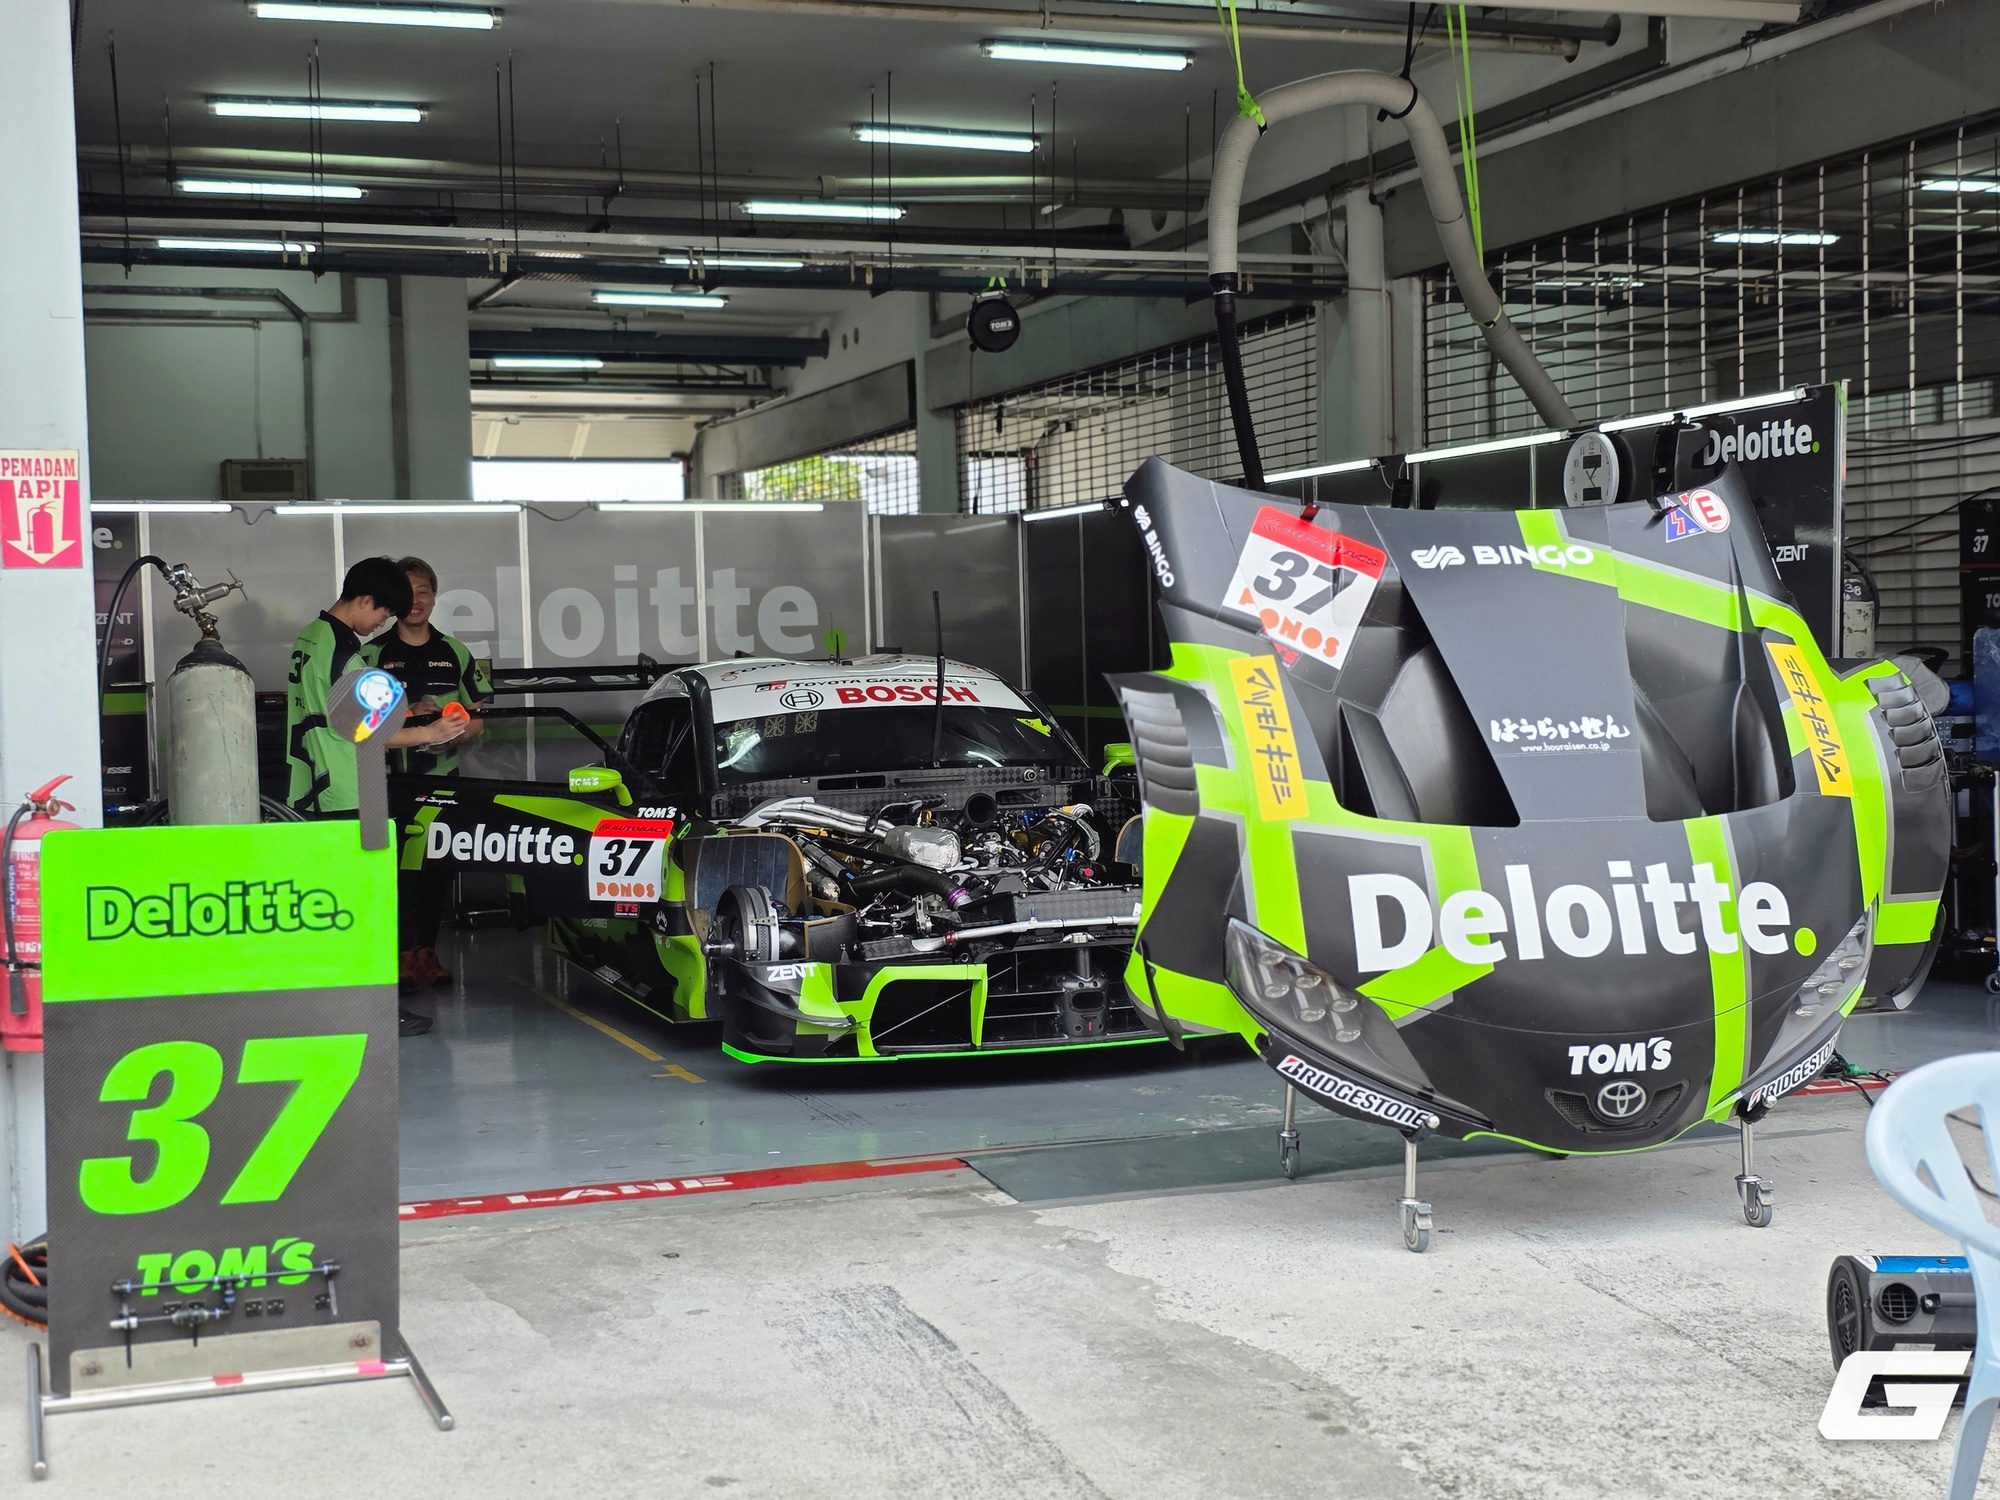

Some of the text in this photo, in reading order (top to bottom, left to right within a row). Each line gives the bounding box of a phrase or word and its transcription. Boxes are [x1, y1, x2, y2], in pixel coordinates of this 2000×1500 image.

[1703, 418, 1820, 466] Deloitte.
[1, 457, 76, 477] PEMADAM
[18, 480, 61, 498] API
[1695, 495, 1722, 523] E
[1145, 529, 1175, 587] BINGO
[1472, 545, 1594, 570] BINGO
[1775, 544, 1809, 562] ZENT
[1973, 535, 1989, 553] 37
[1253, 550, 1358, 615] 37
[437, 565, 849, 660] eloitte.
[1238, 587, 1340, 657] PONOS
[792, 679, 861, 688] TOYOTA
[836, 685, 981, 704] BOSCH
[1490, 714, 1631, 743] ほうらいせん
[1784, 654, 1841, 782] マツモトキヨシ
[1244, 667, 1293, 805] マツモトキヨシ
[1520, 741, 1611, 752] www.houraisen.co.jp
[637, 806, 678, 819] TOM'S
[427, 821, 584, 866] Deloitte.
[611, 825, 668, 834] AUTOBACS
[599, 839, 655, 877] 37
[596, 882, 656, 899] PONOS
[86, 879, 355, 941] Deloitte.
[615, 903, 638, 912] ETS
[1347, 860, 1818, 974] Deloitte.
[767, 963, 817, 982] ZENT
[1568, 1037, 1673, 1076] TOM'S
[1280, 1056, 1431, 1128] BRIDGESTONE
[78, 1033, 369, 1216] 37
[136, 1237, 316, 1297] TOM'S
